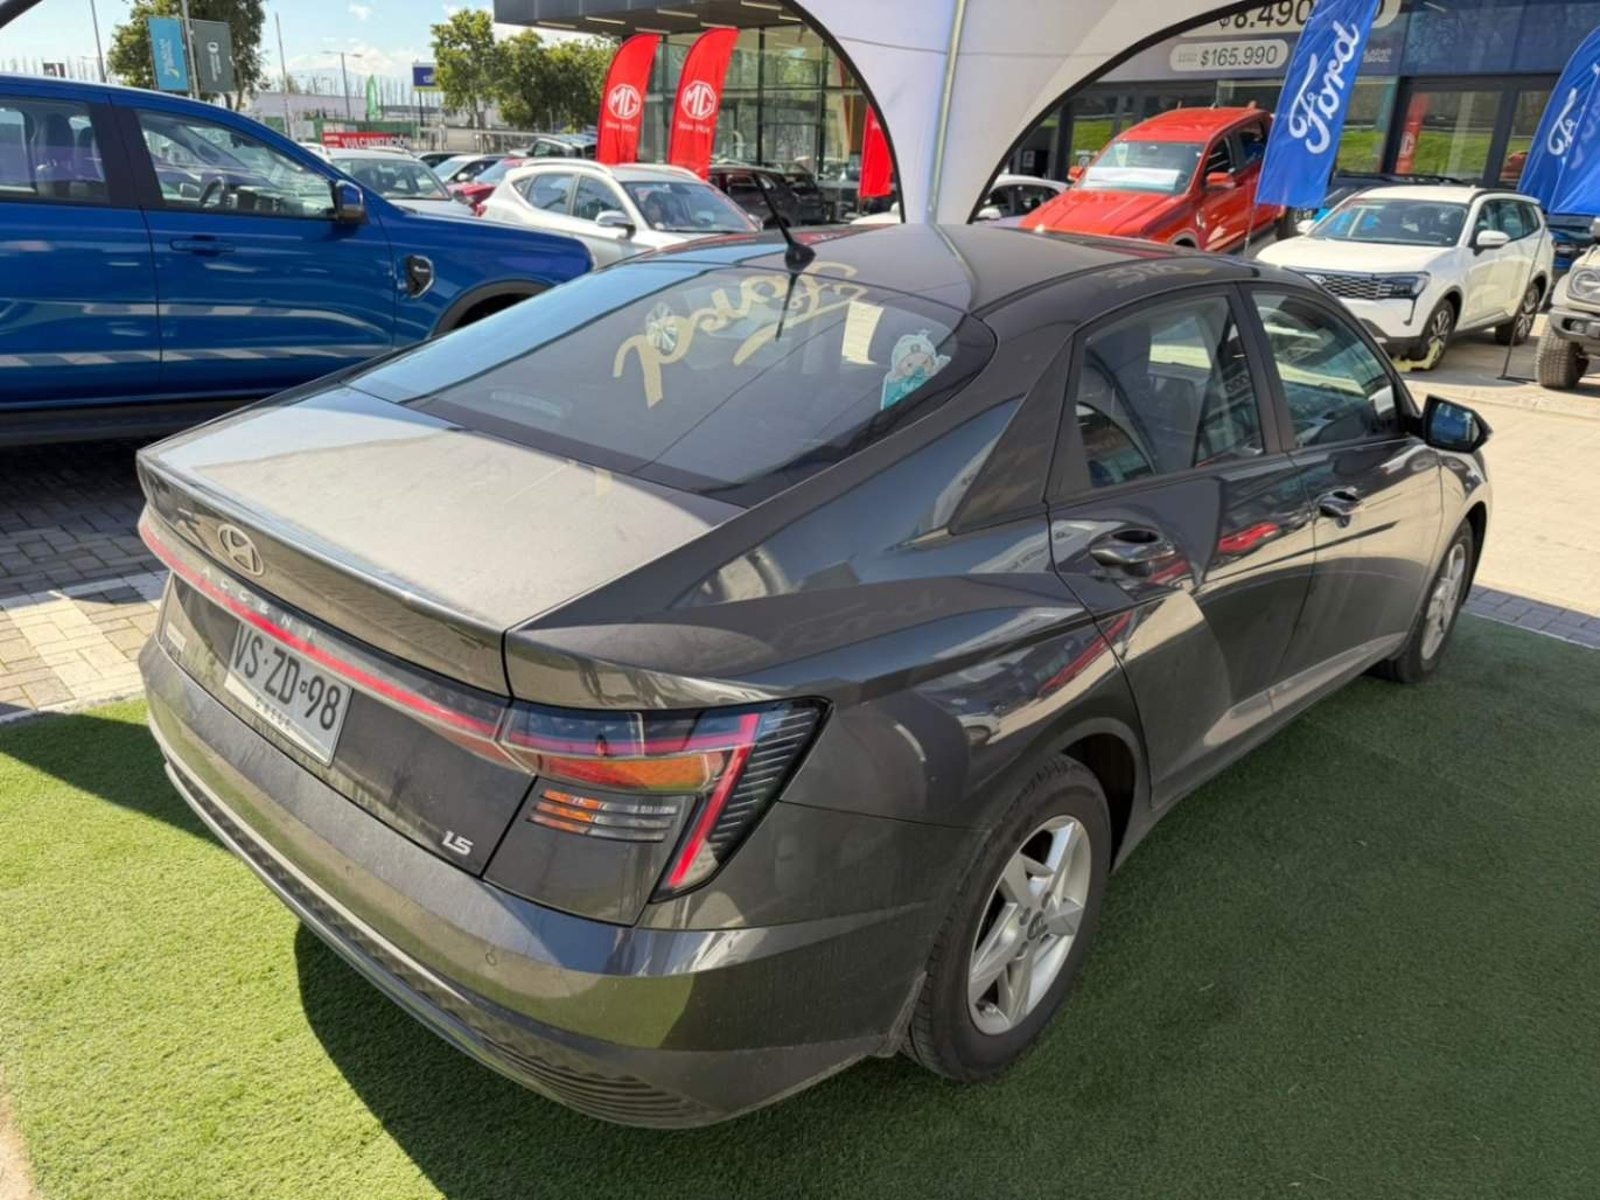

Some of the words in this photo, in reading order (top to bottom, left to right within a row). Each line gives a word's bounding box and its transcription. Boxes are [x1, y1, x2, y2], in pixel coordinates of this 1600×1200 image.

[1201, 45, 1278, 66] $165.990
[611, 87, 639, 117] MG
[684, 84, 715, 117] MG
[1289, 20, 1360, 154] Ford
[201, 566, 317, 638] ACCENT
